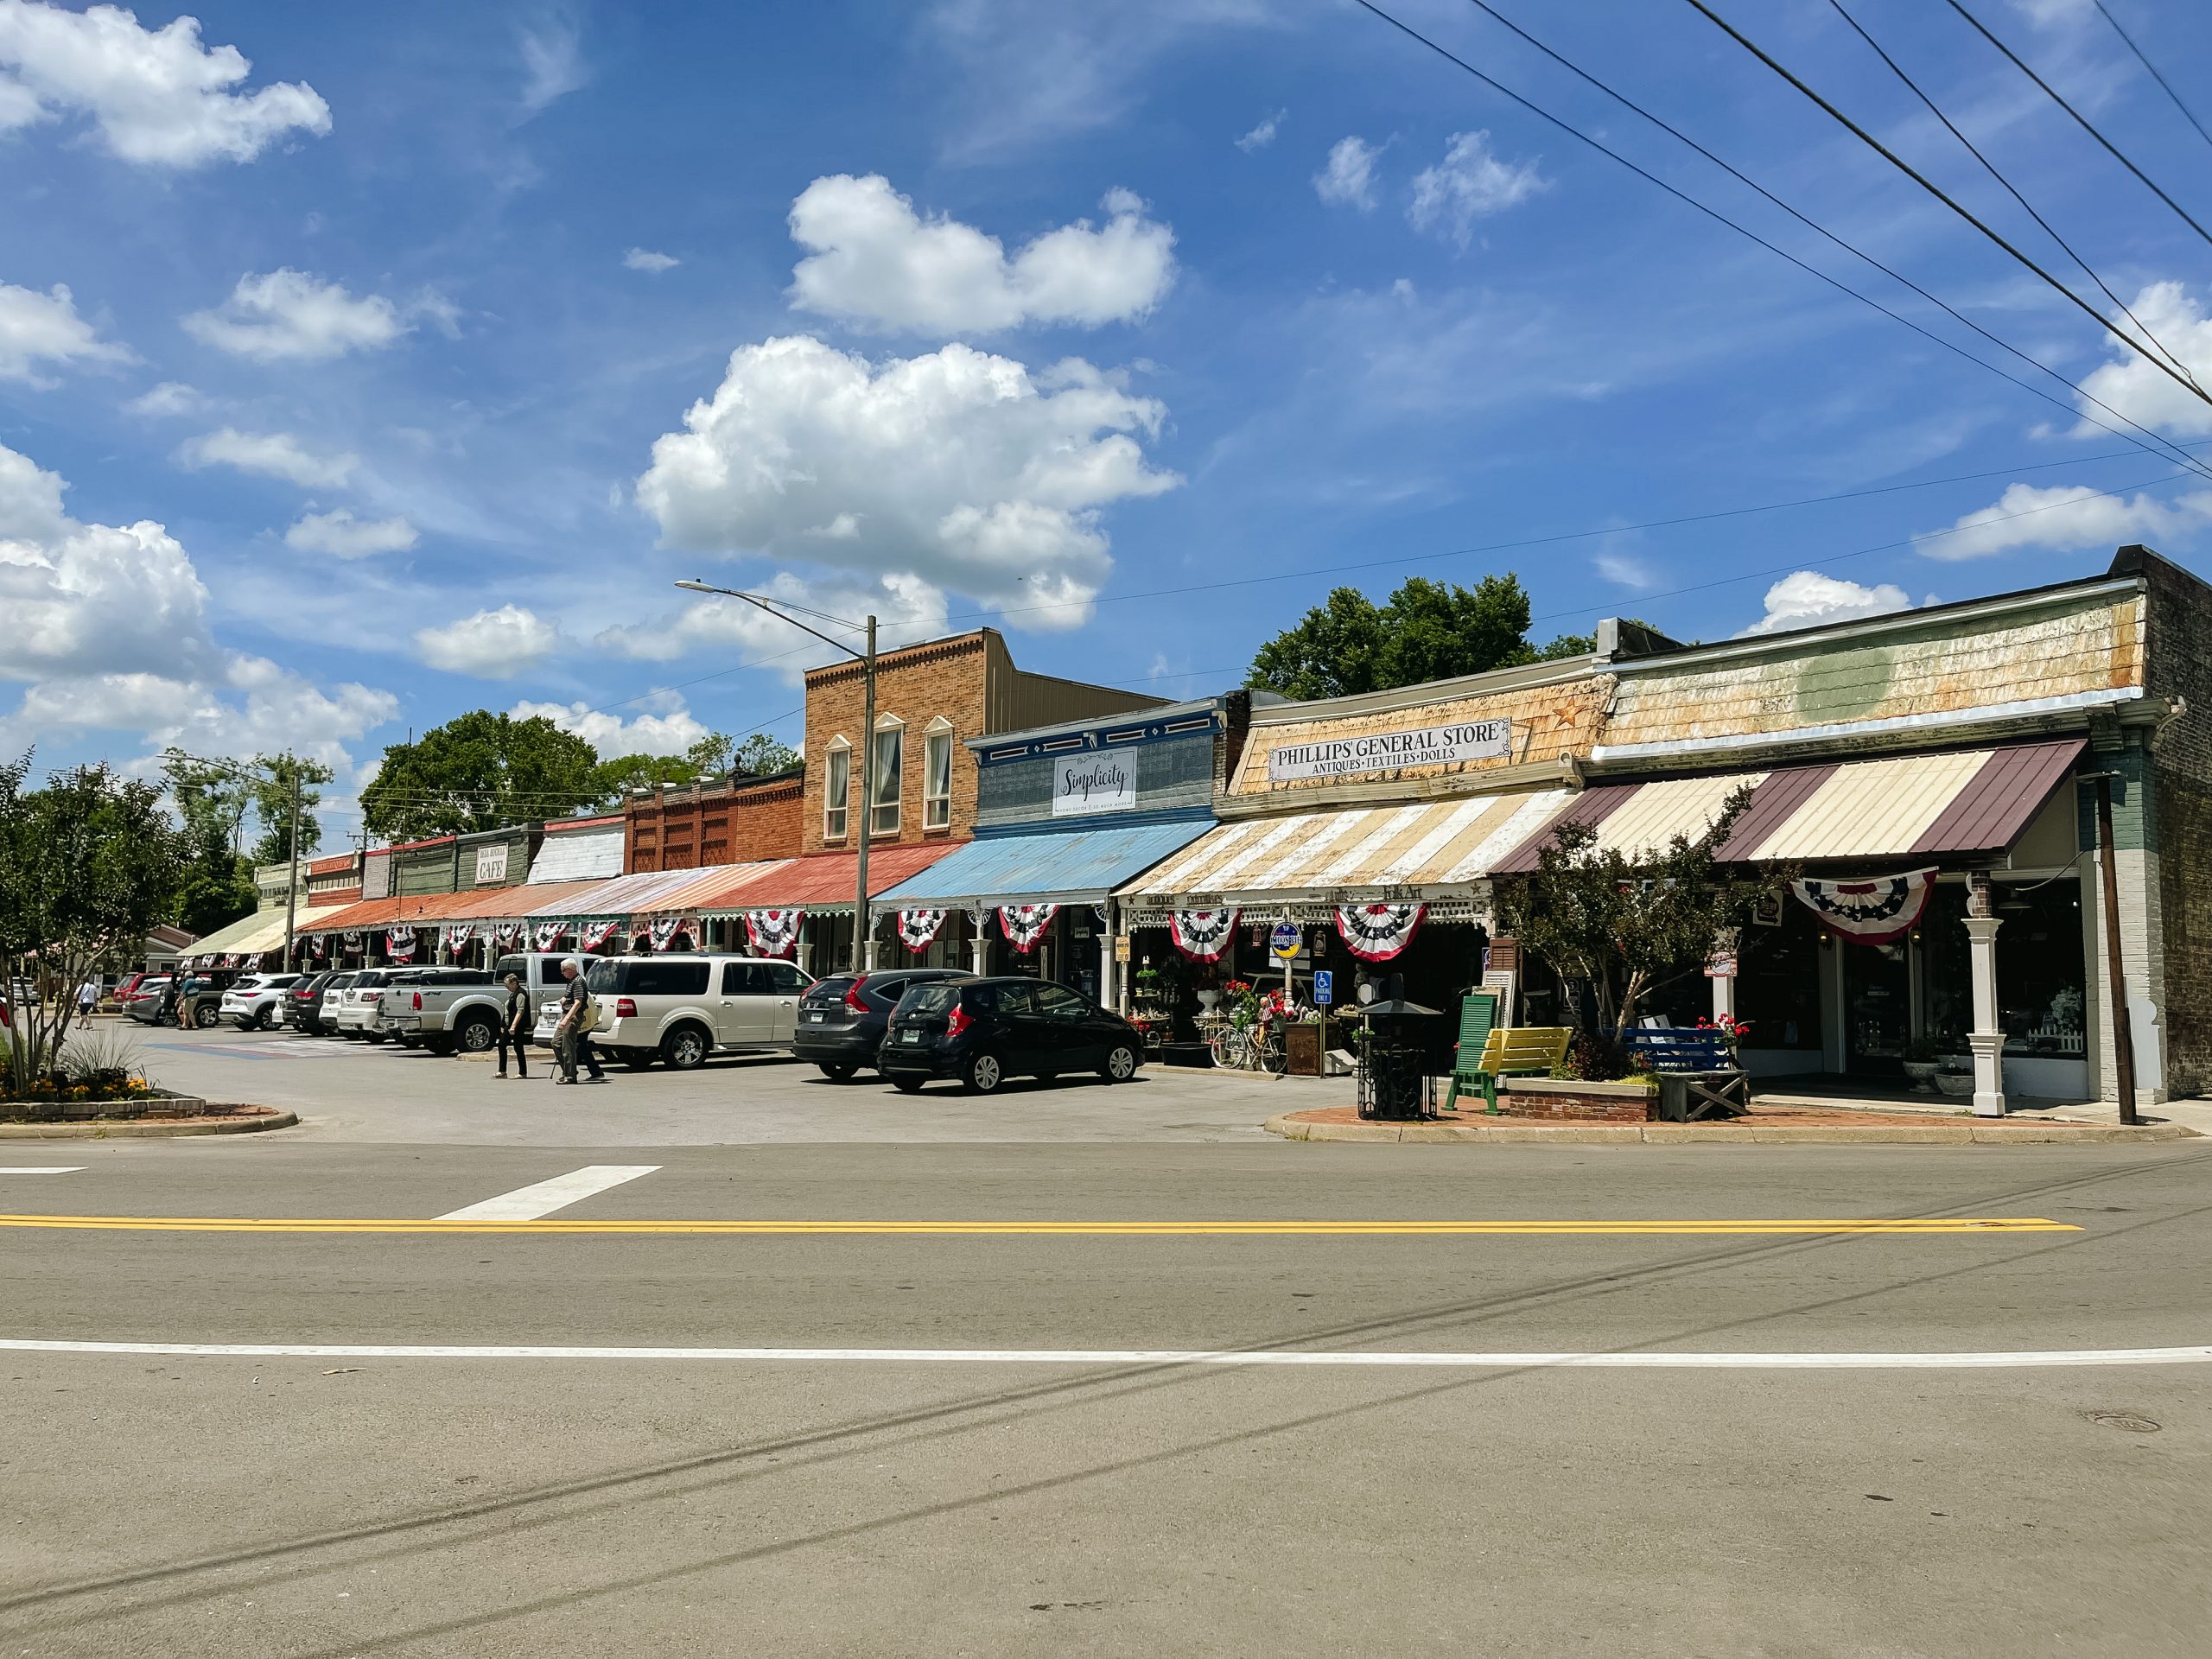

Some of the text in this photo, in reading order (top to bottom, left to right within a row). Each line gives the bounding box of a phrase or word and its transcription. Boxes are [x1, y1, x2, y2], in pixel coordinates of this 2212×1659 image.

[1277, 723, 1500, 766] PHILLIPS' GENERAL STORE
[1312, 747, 1456, 774] ANTIQUES TEXTILES DOLLS
[1060, 764, 1129, 802] Simplicity
[480, 861, 503, 879] CAFE
[1405, 884, 1422, 899] Art
